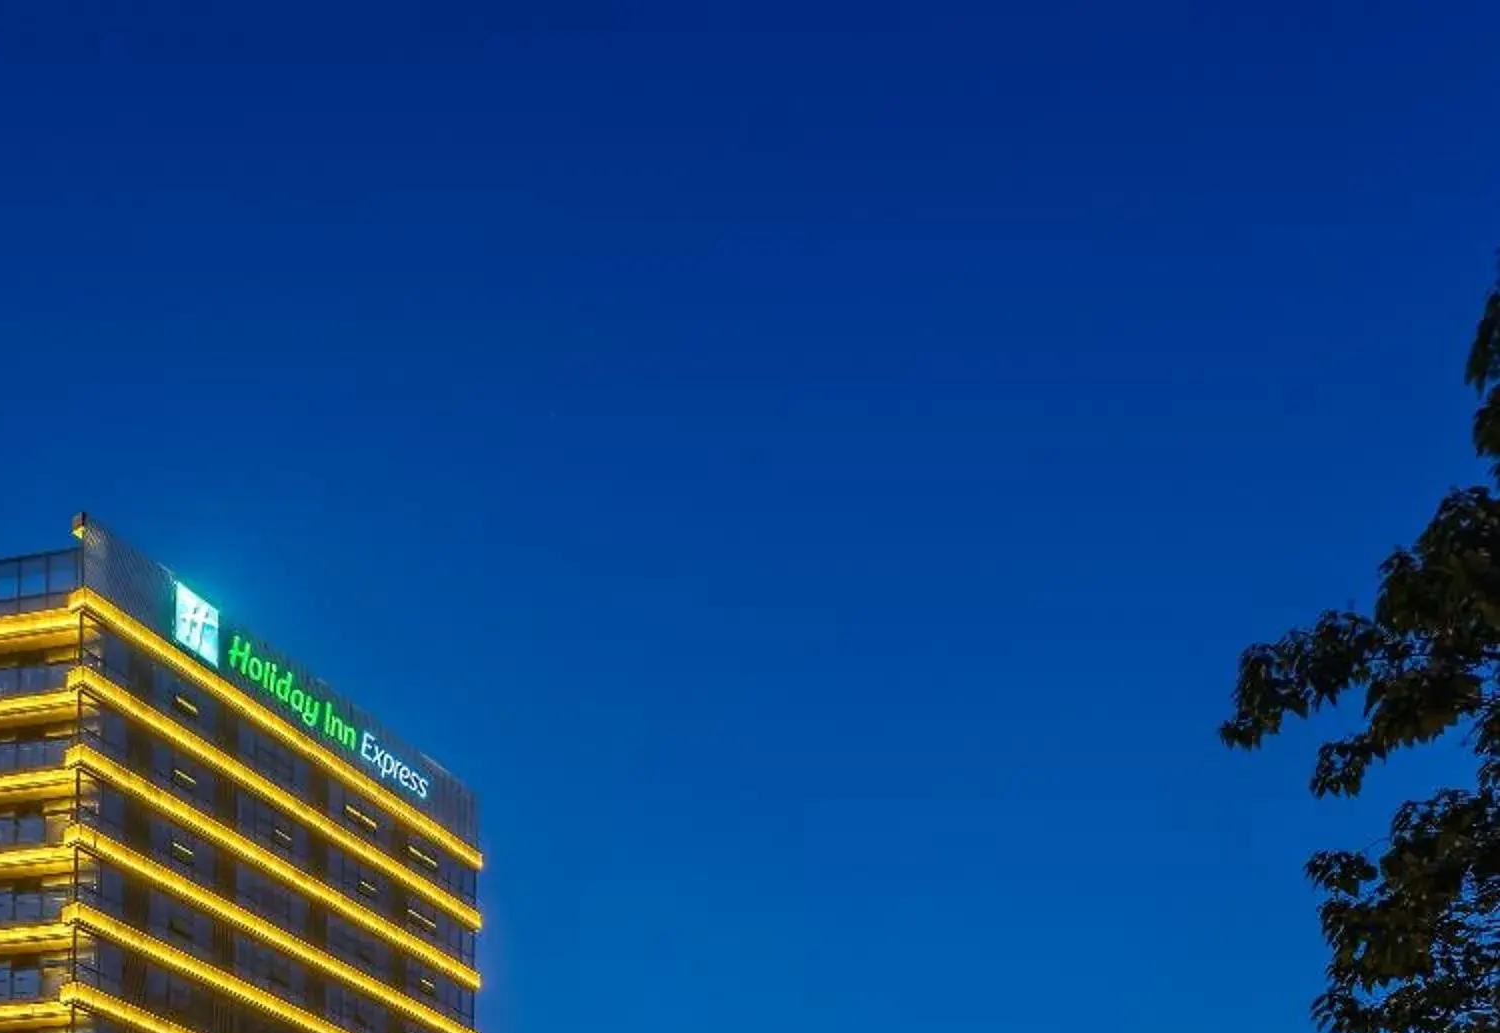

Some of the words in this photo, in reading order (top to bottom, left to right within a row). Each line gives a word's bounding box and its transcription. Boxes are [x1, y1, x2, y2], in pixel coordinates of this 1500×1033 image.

[229, 635, 320, 726] Holiday
[325, 703, 356, 750] Inn
[361, 732, 429, 798] Express
